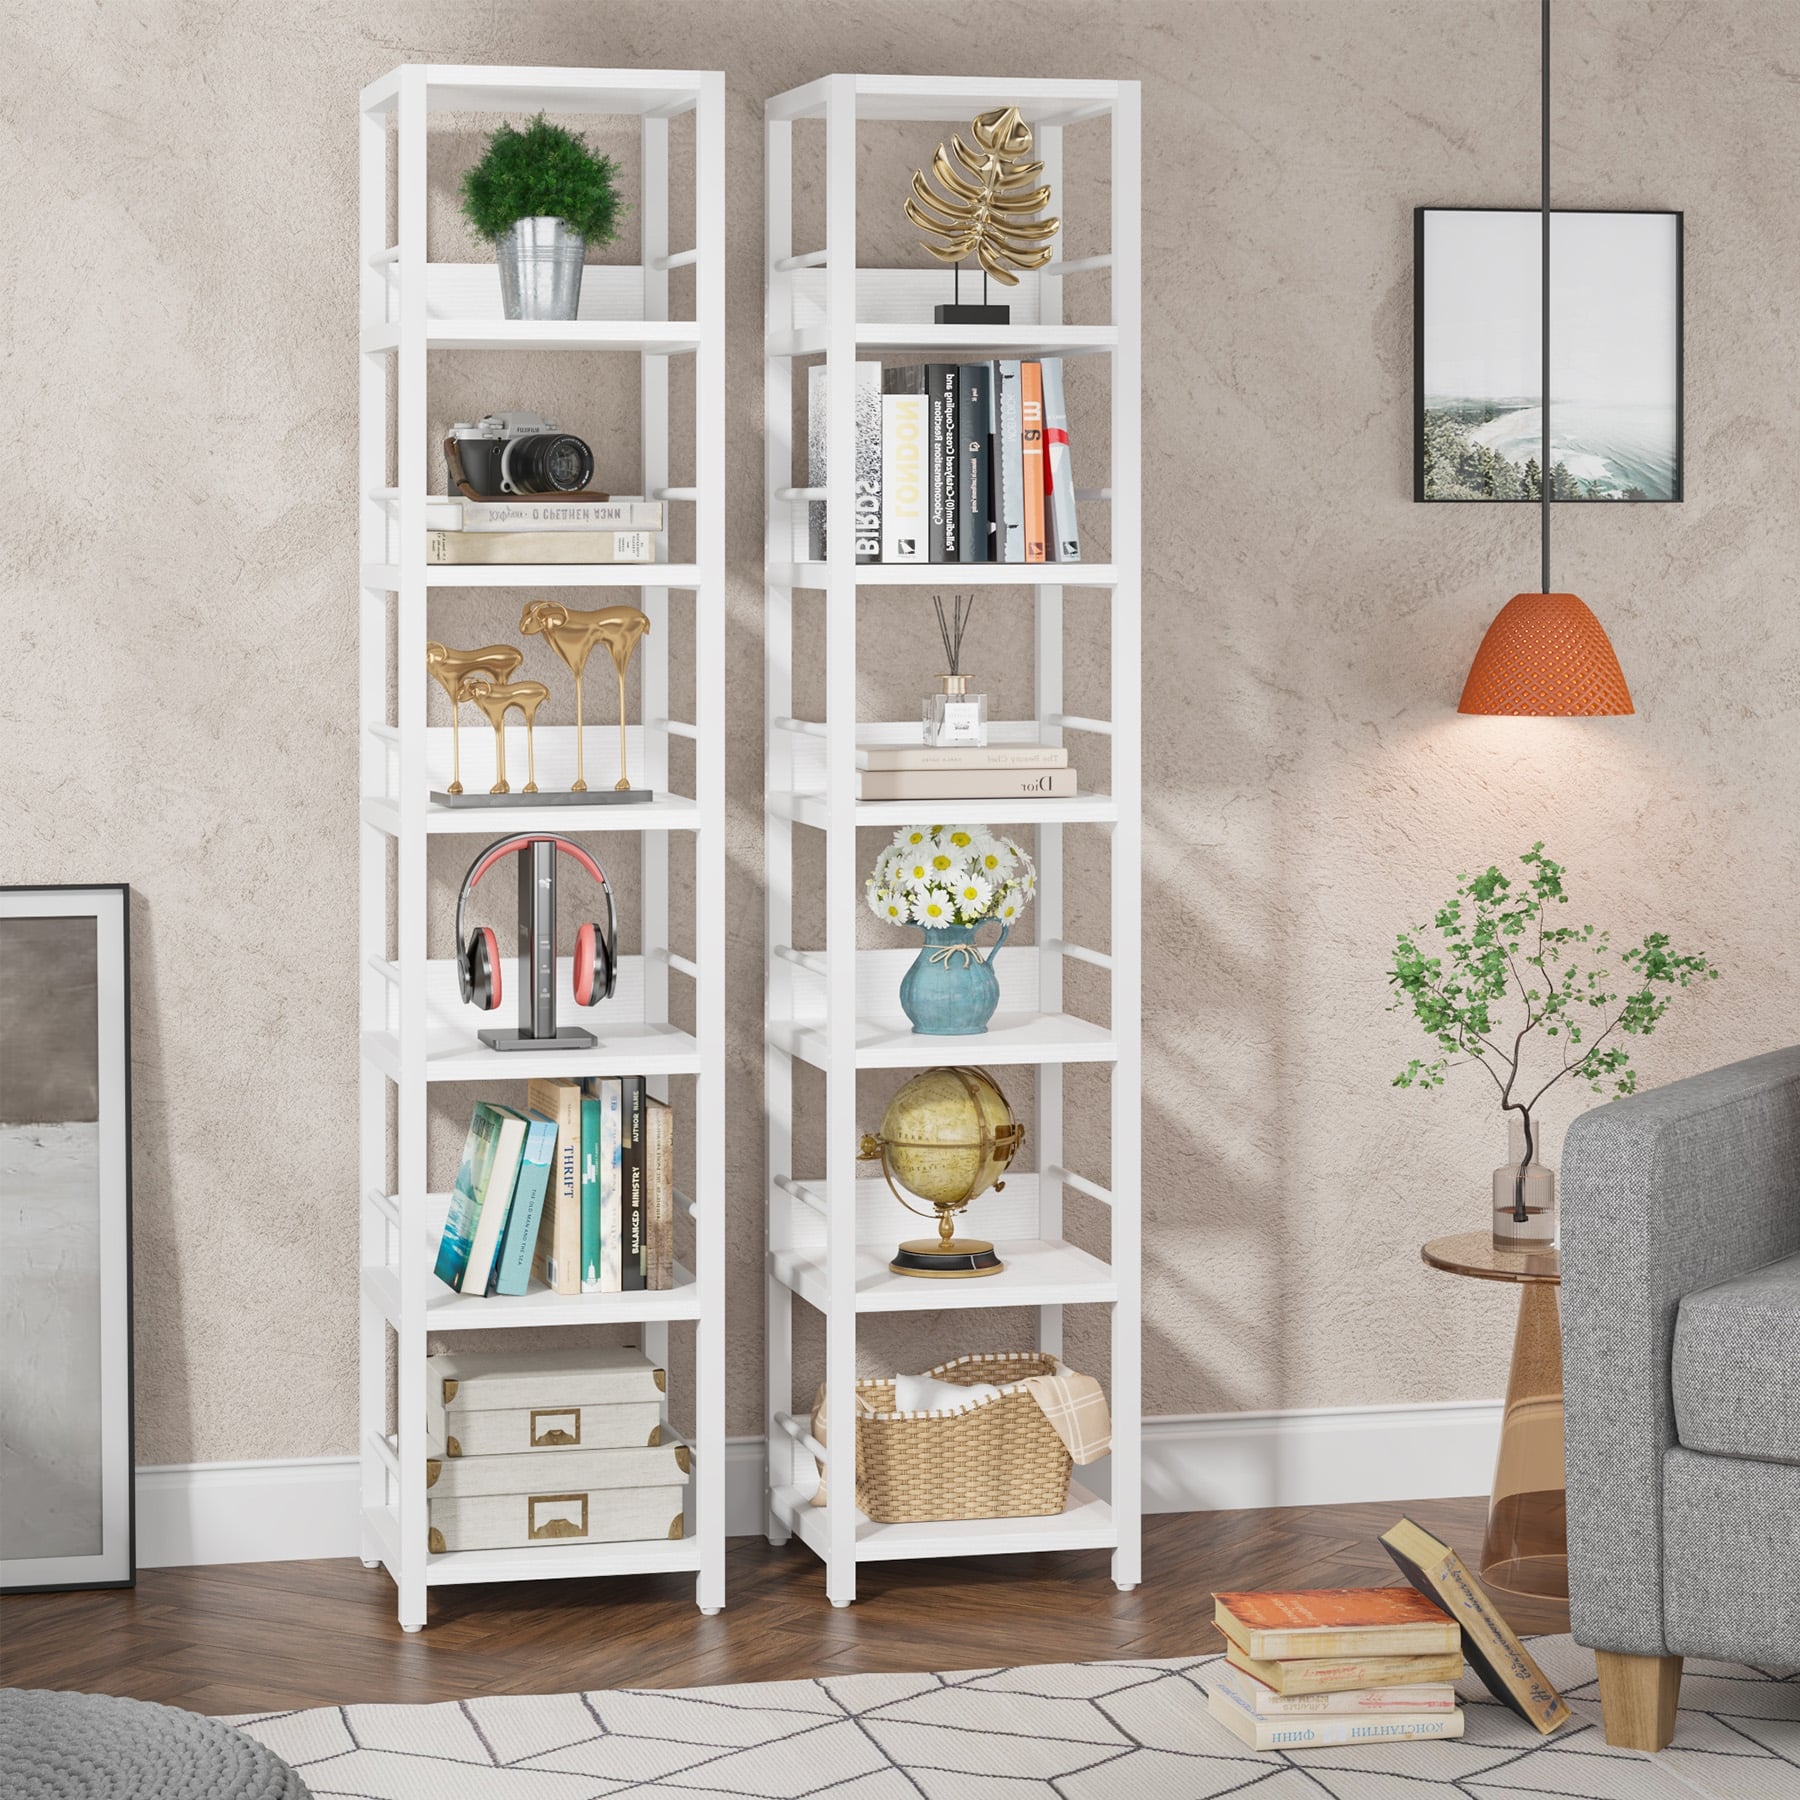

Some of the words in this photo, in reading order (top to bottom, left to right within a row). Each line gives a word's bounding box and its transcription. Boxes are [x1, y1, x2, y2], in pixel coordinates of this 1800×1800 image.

[632, 1113, 640, 1143] AUTHOR
[563, 1145, 575, 1199] THRIFT
[631, 1166, 640, 1208] MINISTRY
[631, 1210, 640, 1255] BALANCED
[1272, 1728, 1316, 1743] ФИНН
[1351, 1722, 1444, 1738] КОНСТАНТИН
